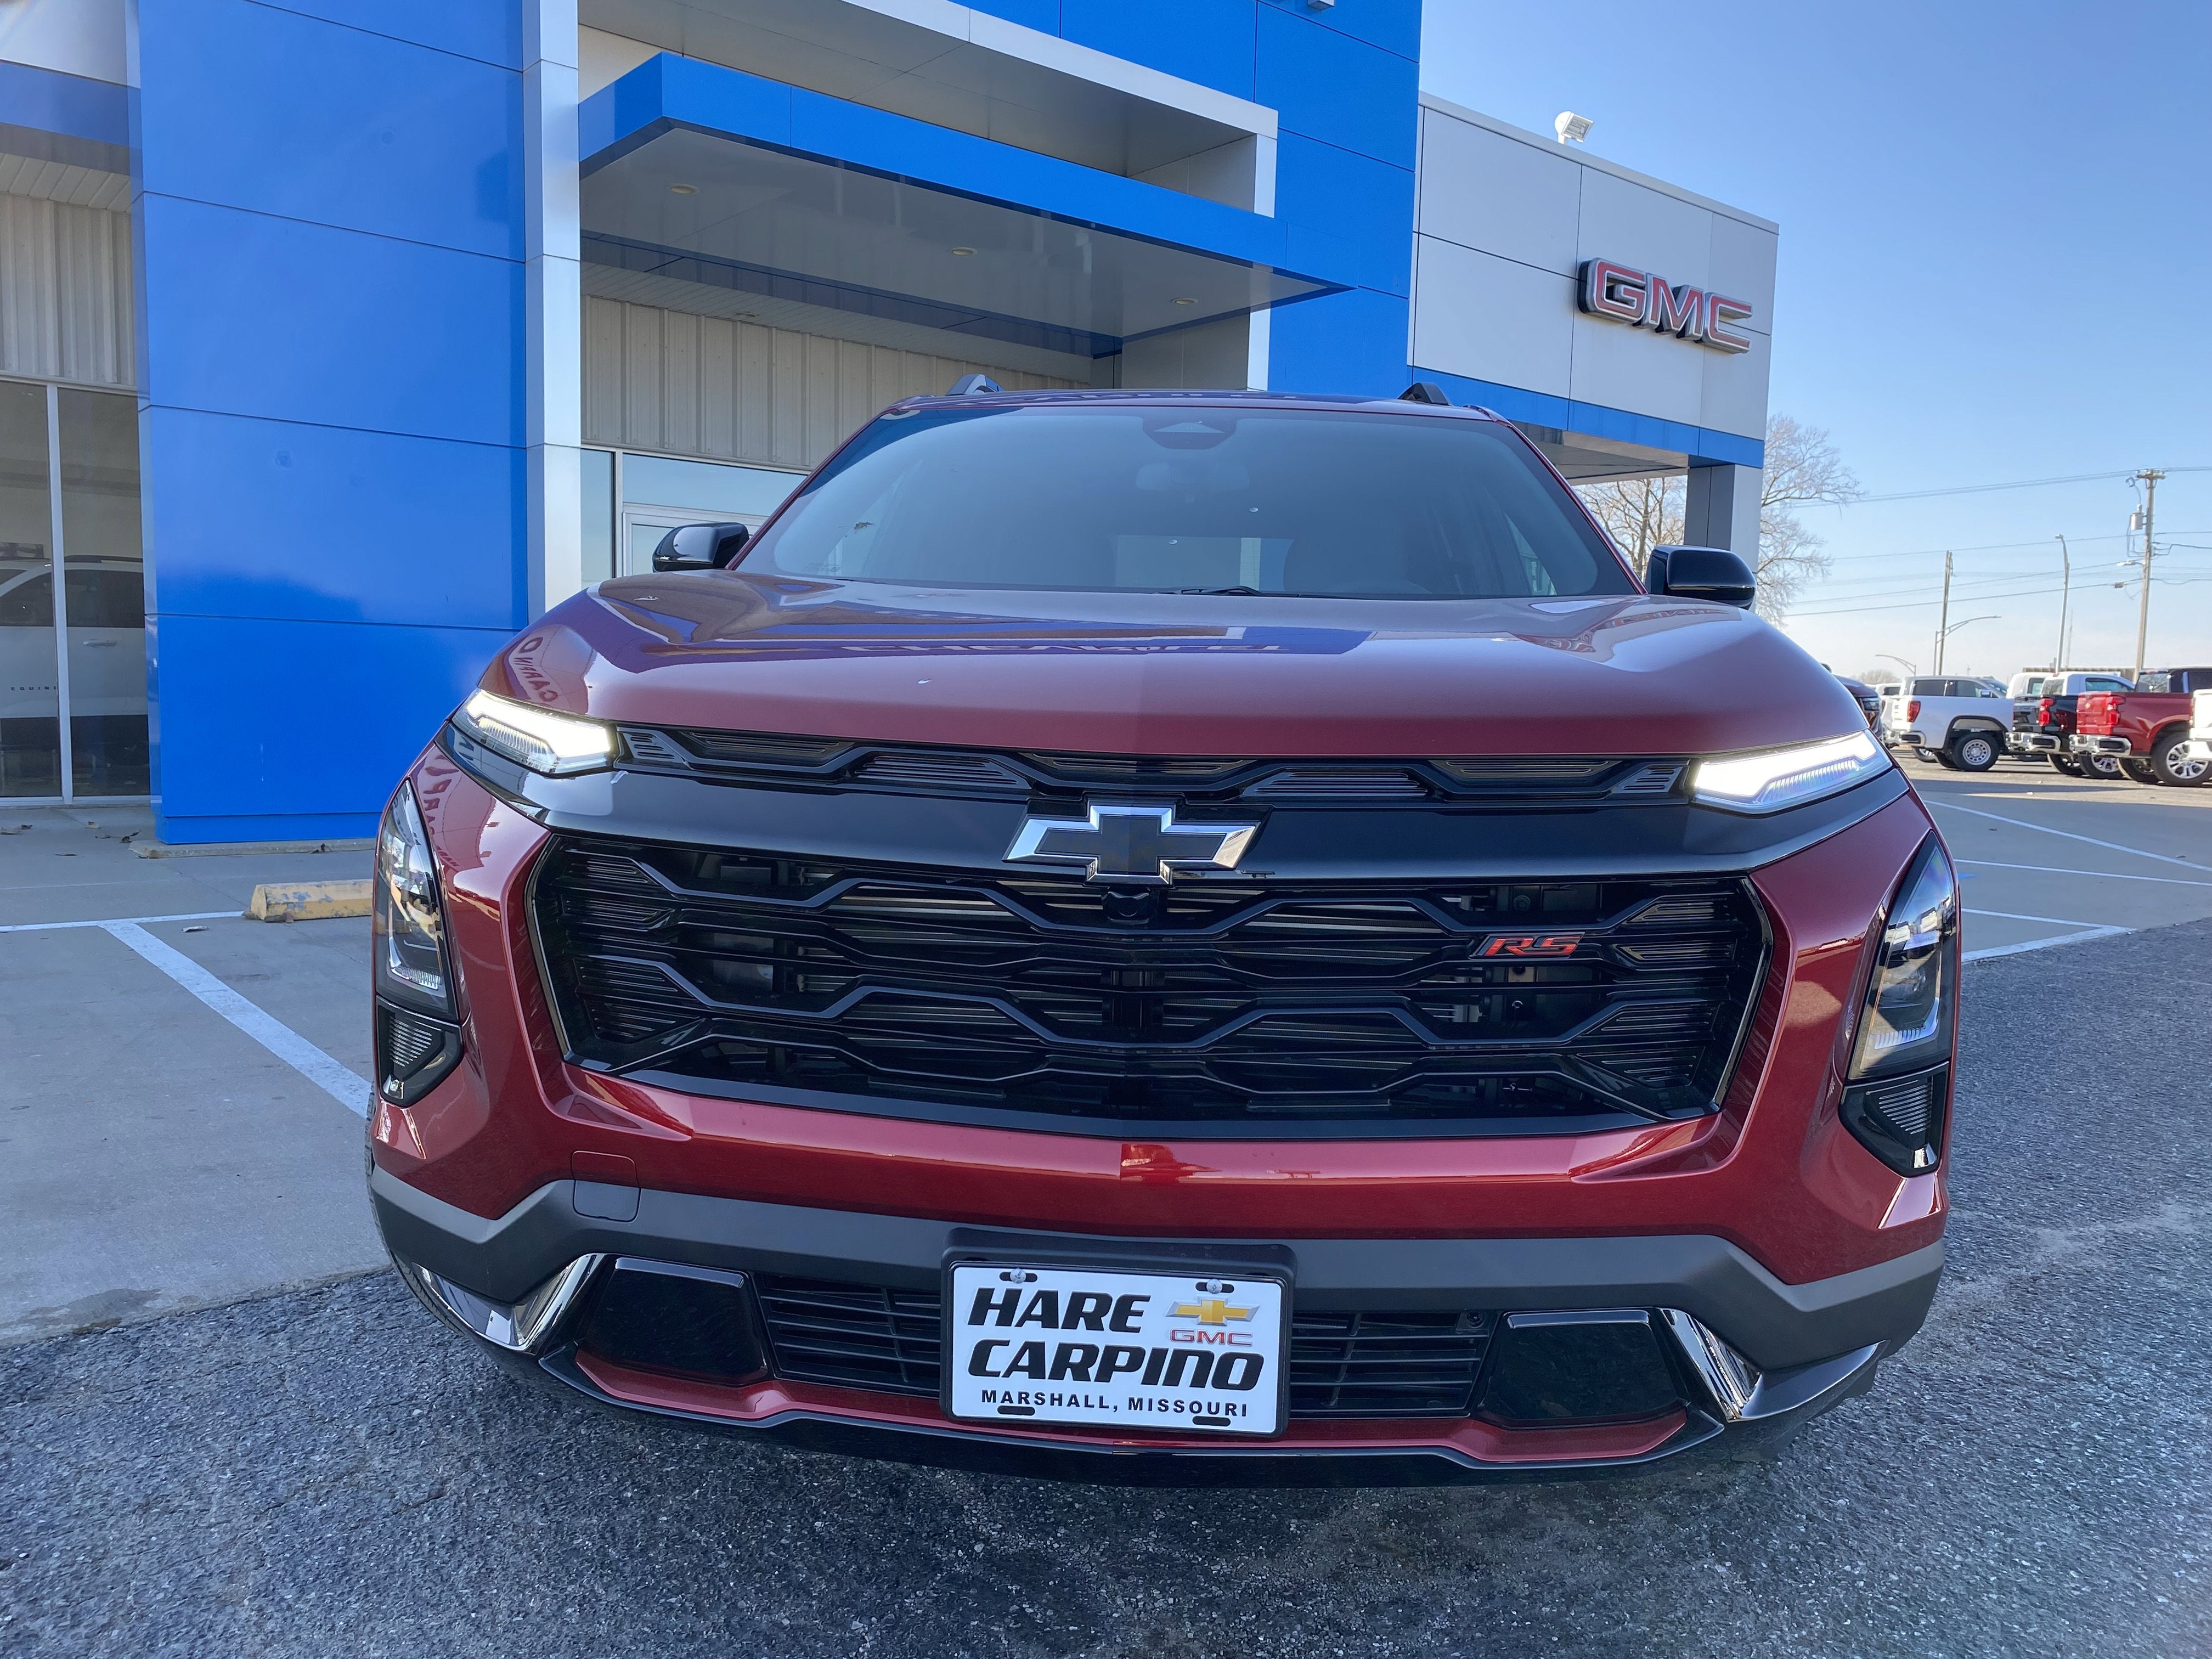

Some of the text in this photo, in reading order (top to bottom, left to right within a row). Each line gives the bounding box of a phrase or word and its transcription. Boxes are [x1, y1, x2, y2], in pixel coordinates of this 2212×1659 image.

[1578, 257, 1753, 354] GMC
[1481, 934, 1583, 957] RS
[967, 1287, 1151, 1334] HARE
[1170, 1328, 1253, 1347] GMC
[968, 1339, 1264, 1391] CARPINO
[981, 1389, 1247, 1417] MARSHALL, MISSOURI
